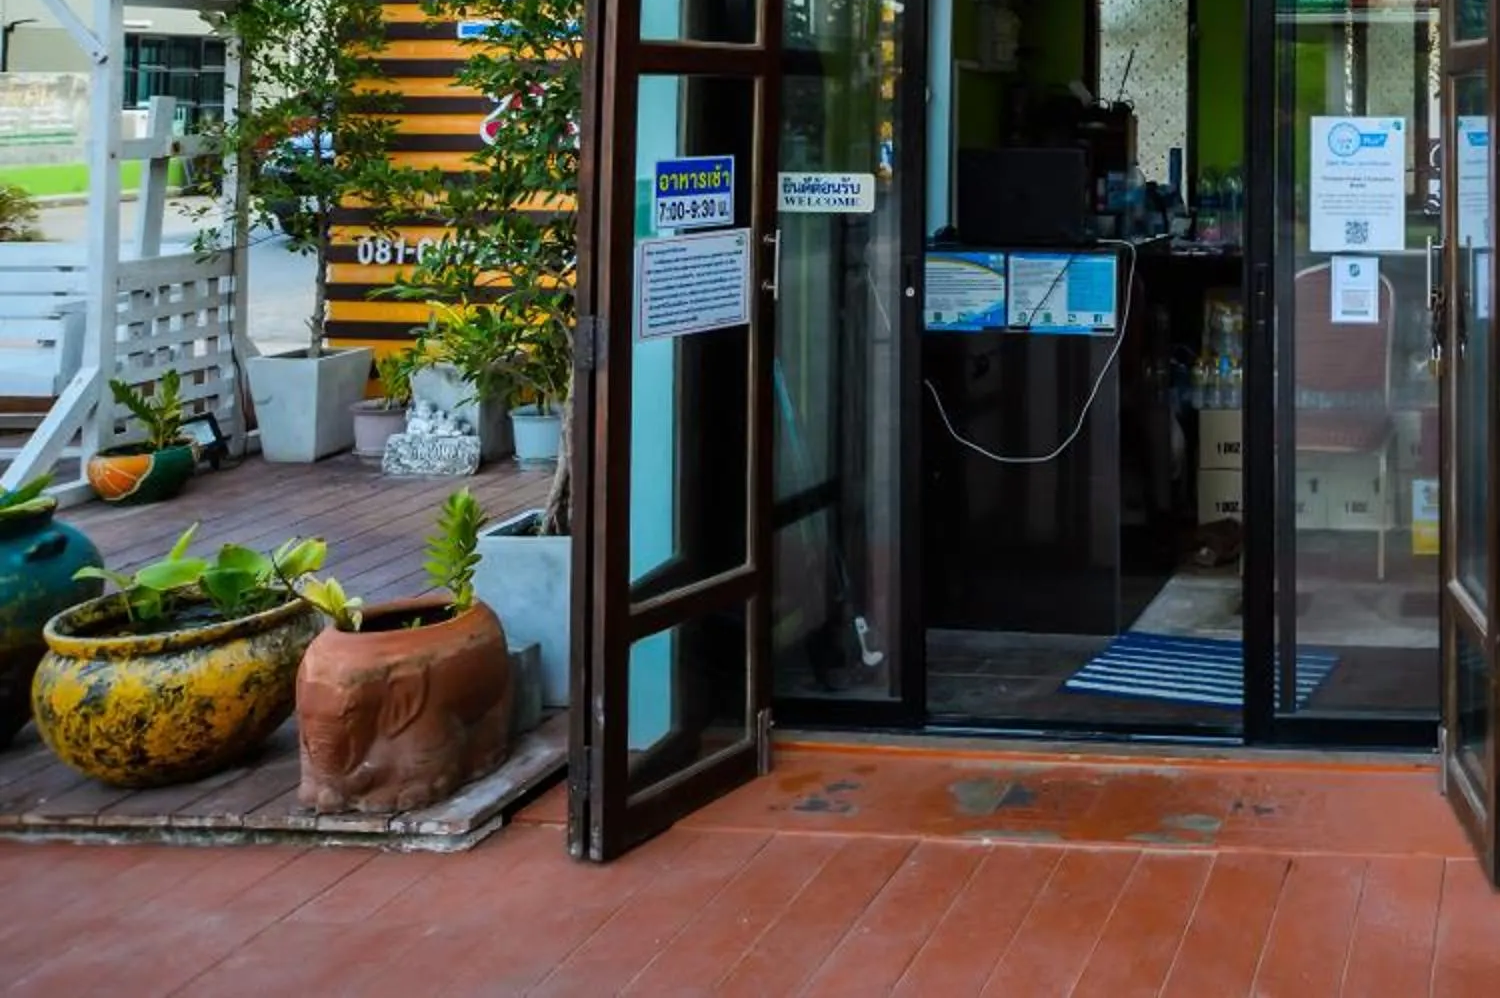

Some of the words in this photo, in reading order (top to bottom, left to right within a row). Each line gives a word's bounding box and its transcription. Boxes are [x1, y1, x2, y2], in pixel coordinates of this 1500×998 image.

[660, 163, 730, 192] อาหารเช้า
[783, 177, 861, 194] ยินดีต้อนรับ
[784, 196, 861, 206] WELCOME
